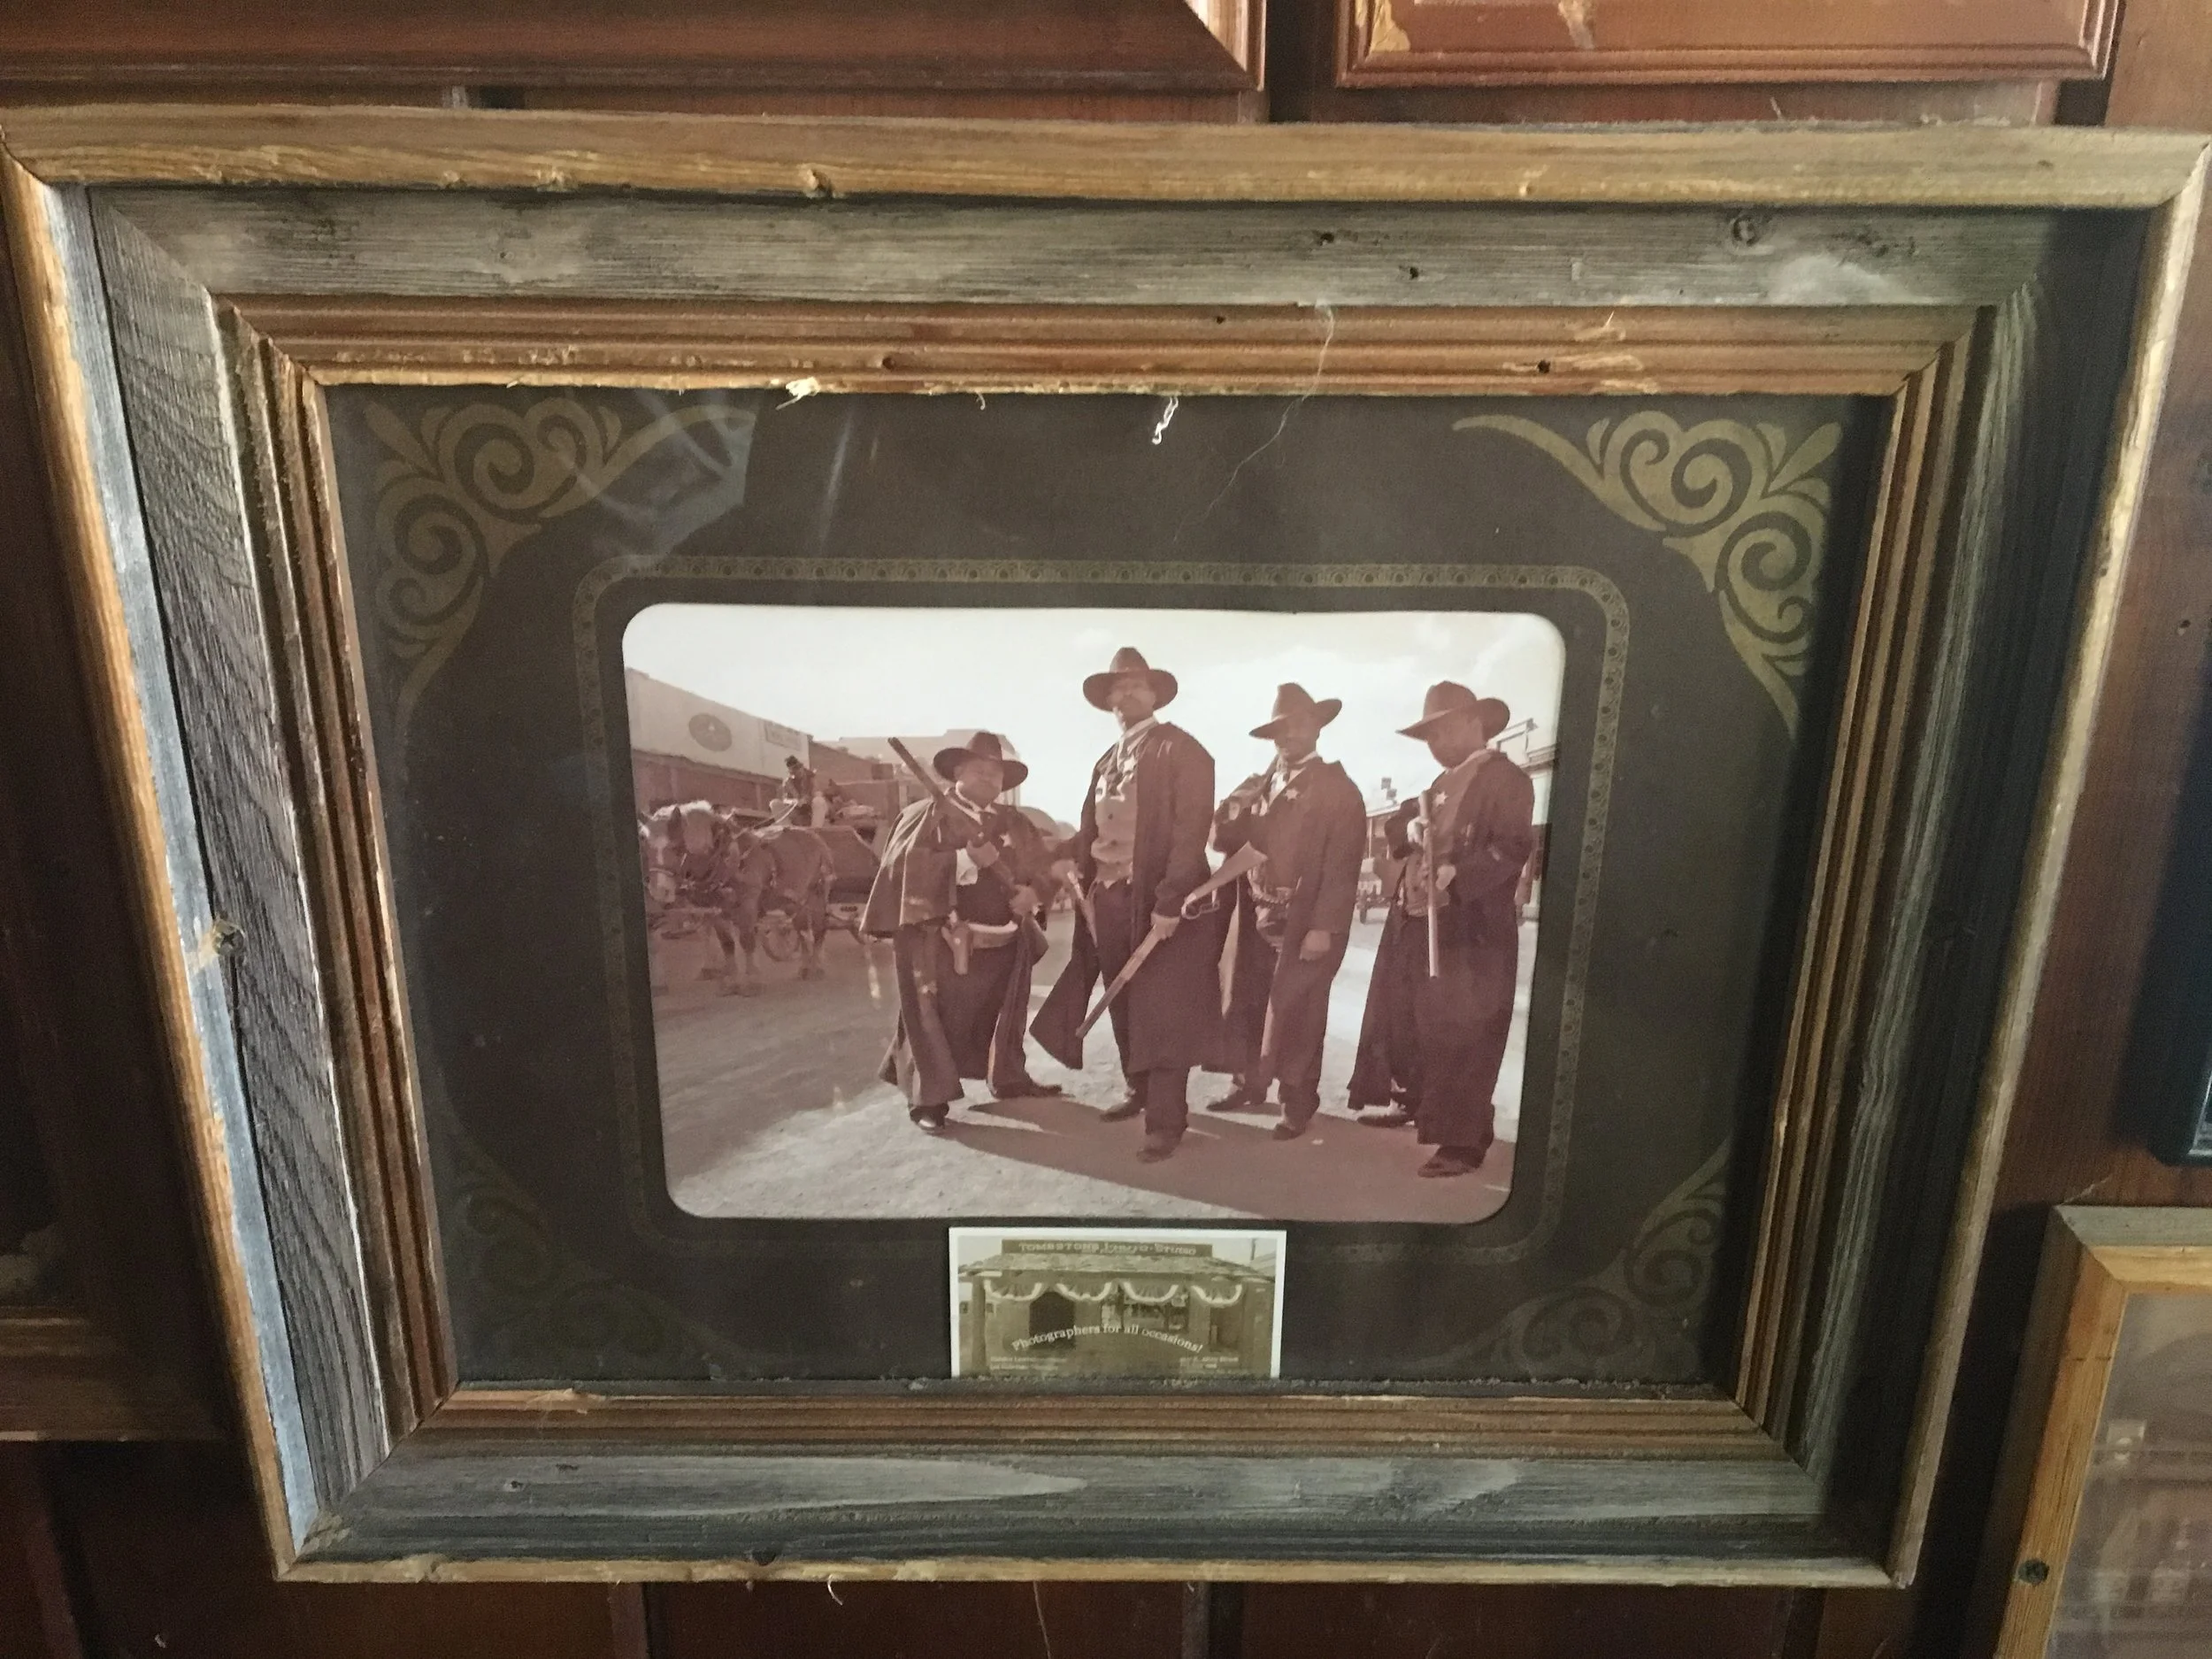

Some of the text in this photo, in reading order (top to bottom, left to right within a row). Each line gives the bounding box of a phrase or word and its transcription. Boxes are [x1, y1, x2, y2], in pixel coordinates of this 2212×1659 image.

[1011, 1324, 1203, 1354] Photographers for all occasions!
